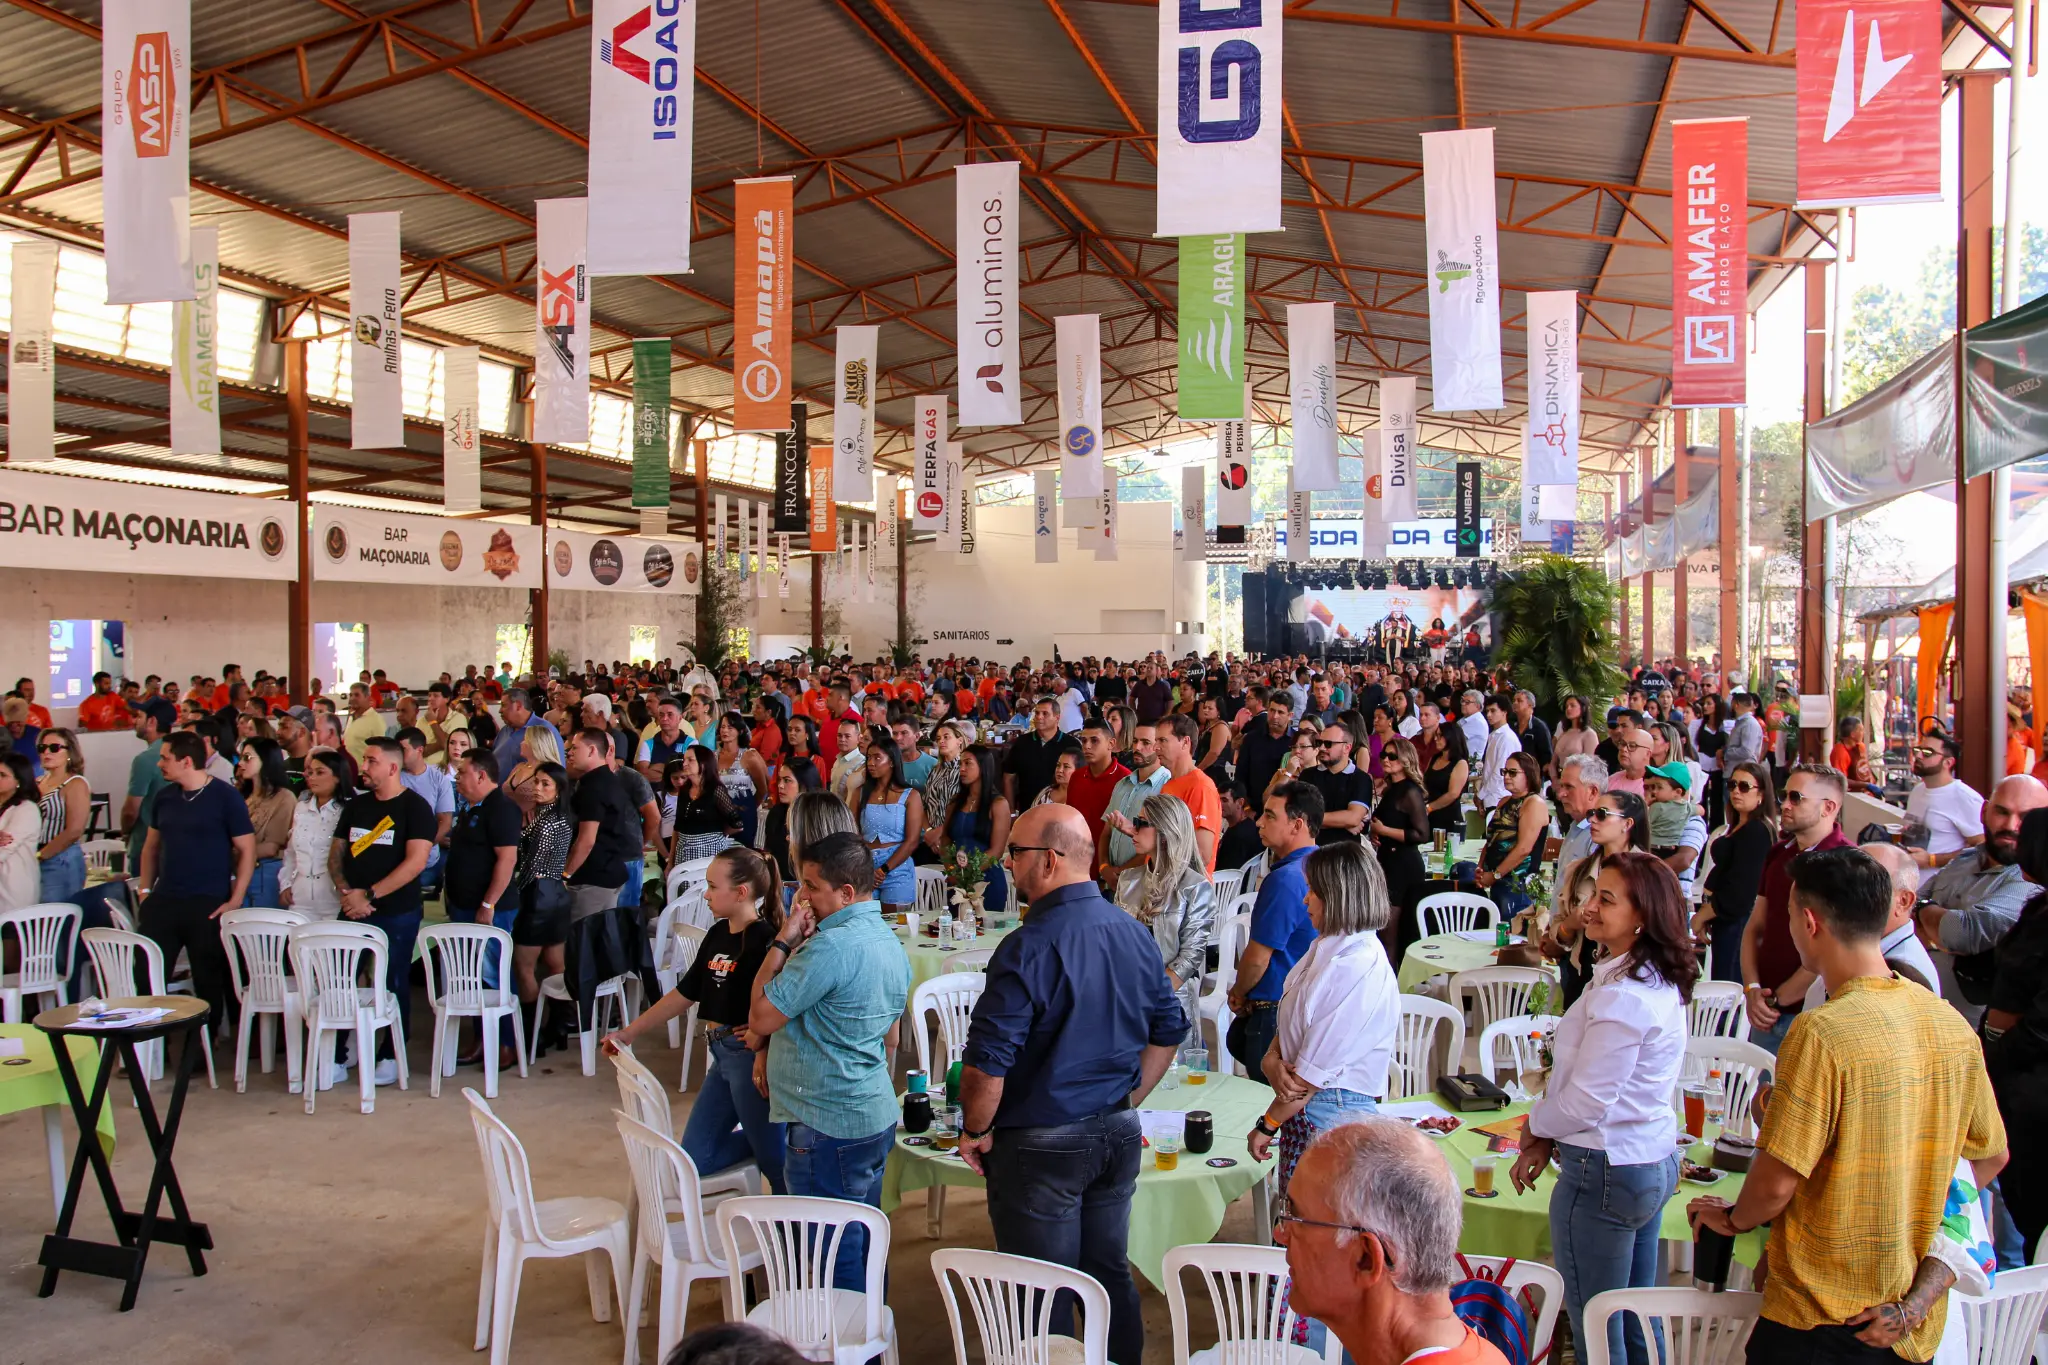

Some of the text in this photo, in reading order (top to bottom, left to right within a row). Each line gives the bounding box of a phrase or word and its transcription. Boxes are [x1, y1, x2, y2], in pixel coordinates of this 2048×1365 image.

[115, 69, 123, 125] GRUPO
[140, 43, 161, 147] MSP
[777, 210, 785, 262] Armazenagem
[1688, 163, 1716, 305] AMAFER
[1720, 203, 1732, 234] AÇO
[752, 209, 775, 358] Amapá
[1472, 235, 1485, 304] Agropecuária
[1720, 258, 1730, 305] FERRO
[383, 288, 396, 321] Ferro
[541, 264, 575, 380] ASX
[196, 264, 213, 413] ARAMETALS
[384, 330, 397, 374] Anilhas
[1075, 354, 1084, 419] CASA AMORIM
[923, 408, 937, 489] FERFAGÁS
[1390, 433, 1405, 487] Divisa
[1039, 495, 1048, 525] vagas
[1462, 472, 1473, 525] UNIBRÁS
[0, 502, 250, 550] BAR MAÇONARIA
[384, 527, 408, 542] BAR
[1392, 530, 1430, 545] DA
[360, 547, 431, 567] MAÇONARIA
[1187, 668, 1204, 676] CAIXA
